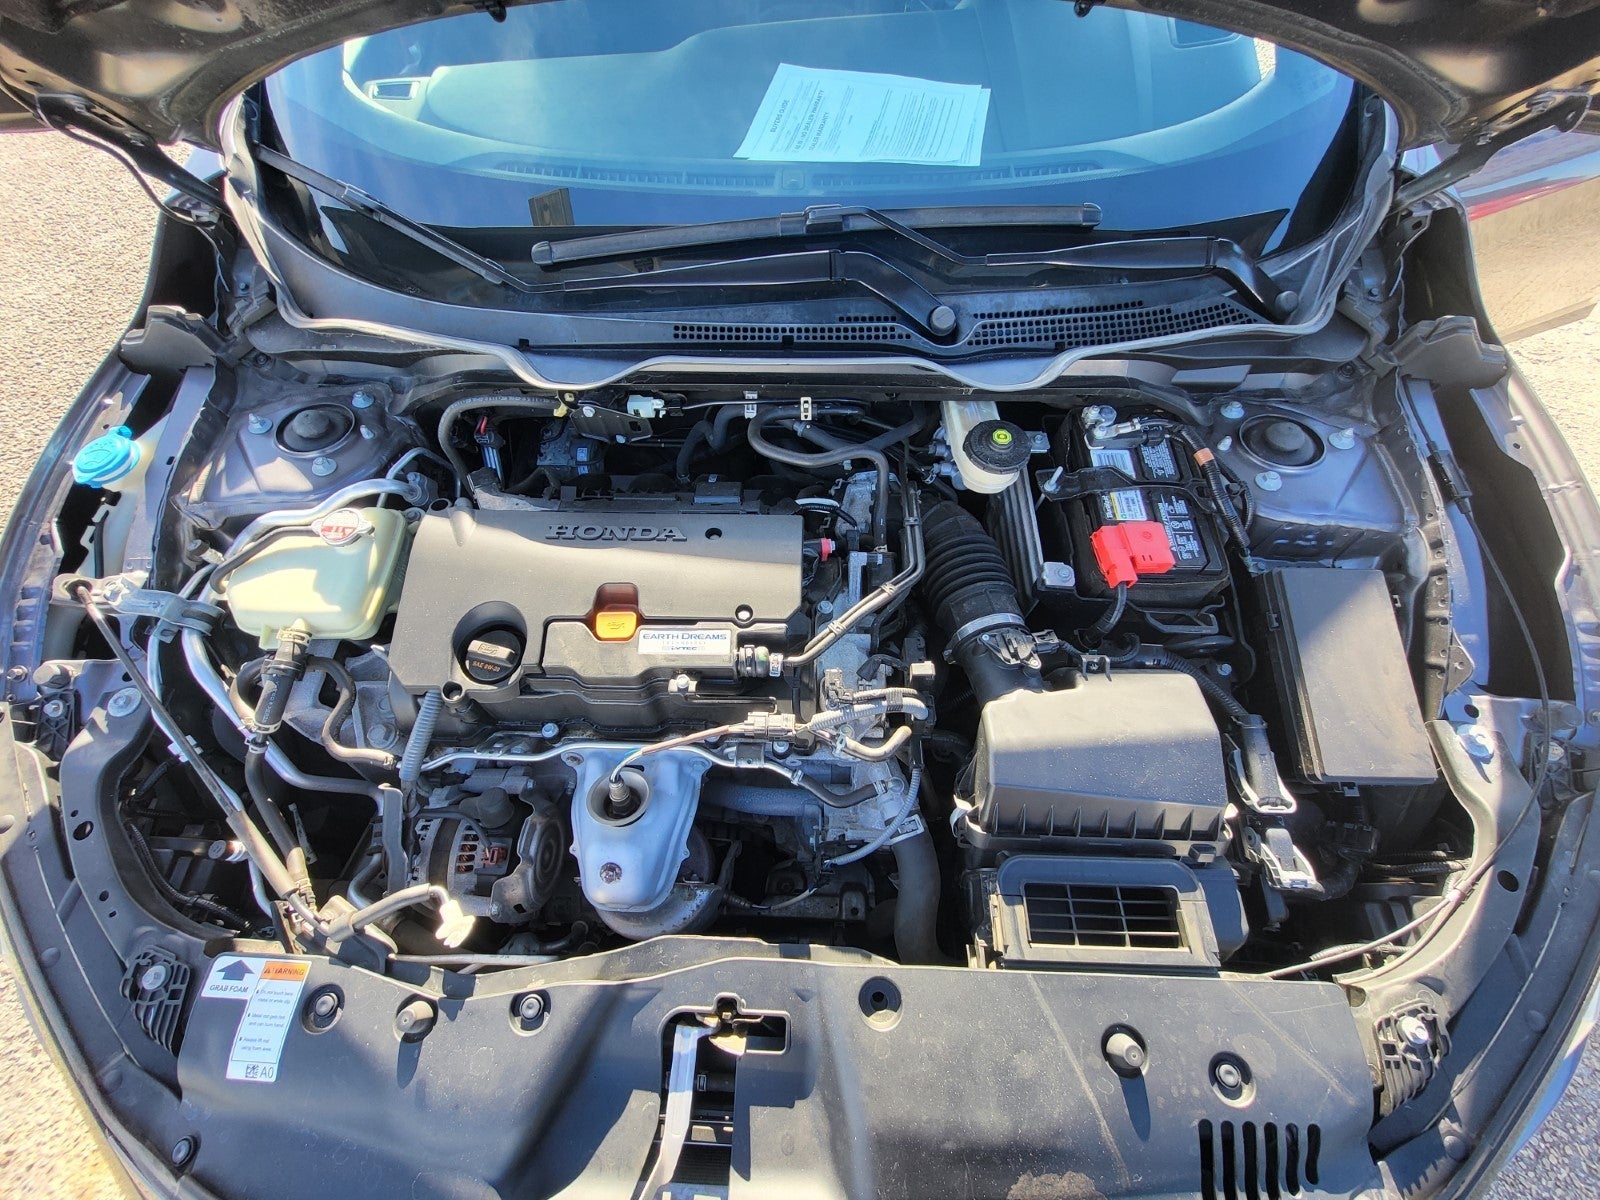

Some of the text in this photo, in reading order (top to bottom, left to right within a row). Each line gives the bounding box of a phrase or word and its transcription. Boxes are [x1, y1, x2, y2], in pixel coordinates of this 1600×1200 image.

[545, 524, 687, 542] HONDA
[681, 632, 727, 640] DREAMS
[209, 984, 249, 993] GRAB FOAM
[260, 1066, 274, 1079] A0
